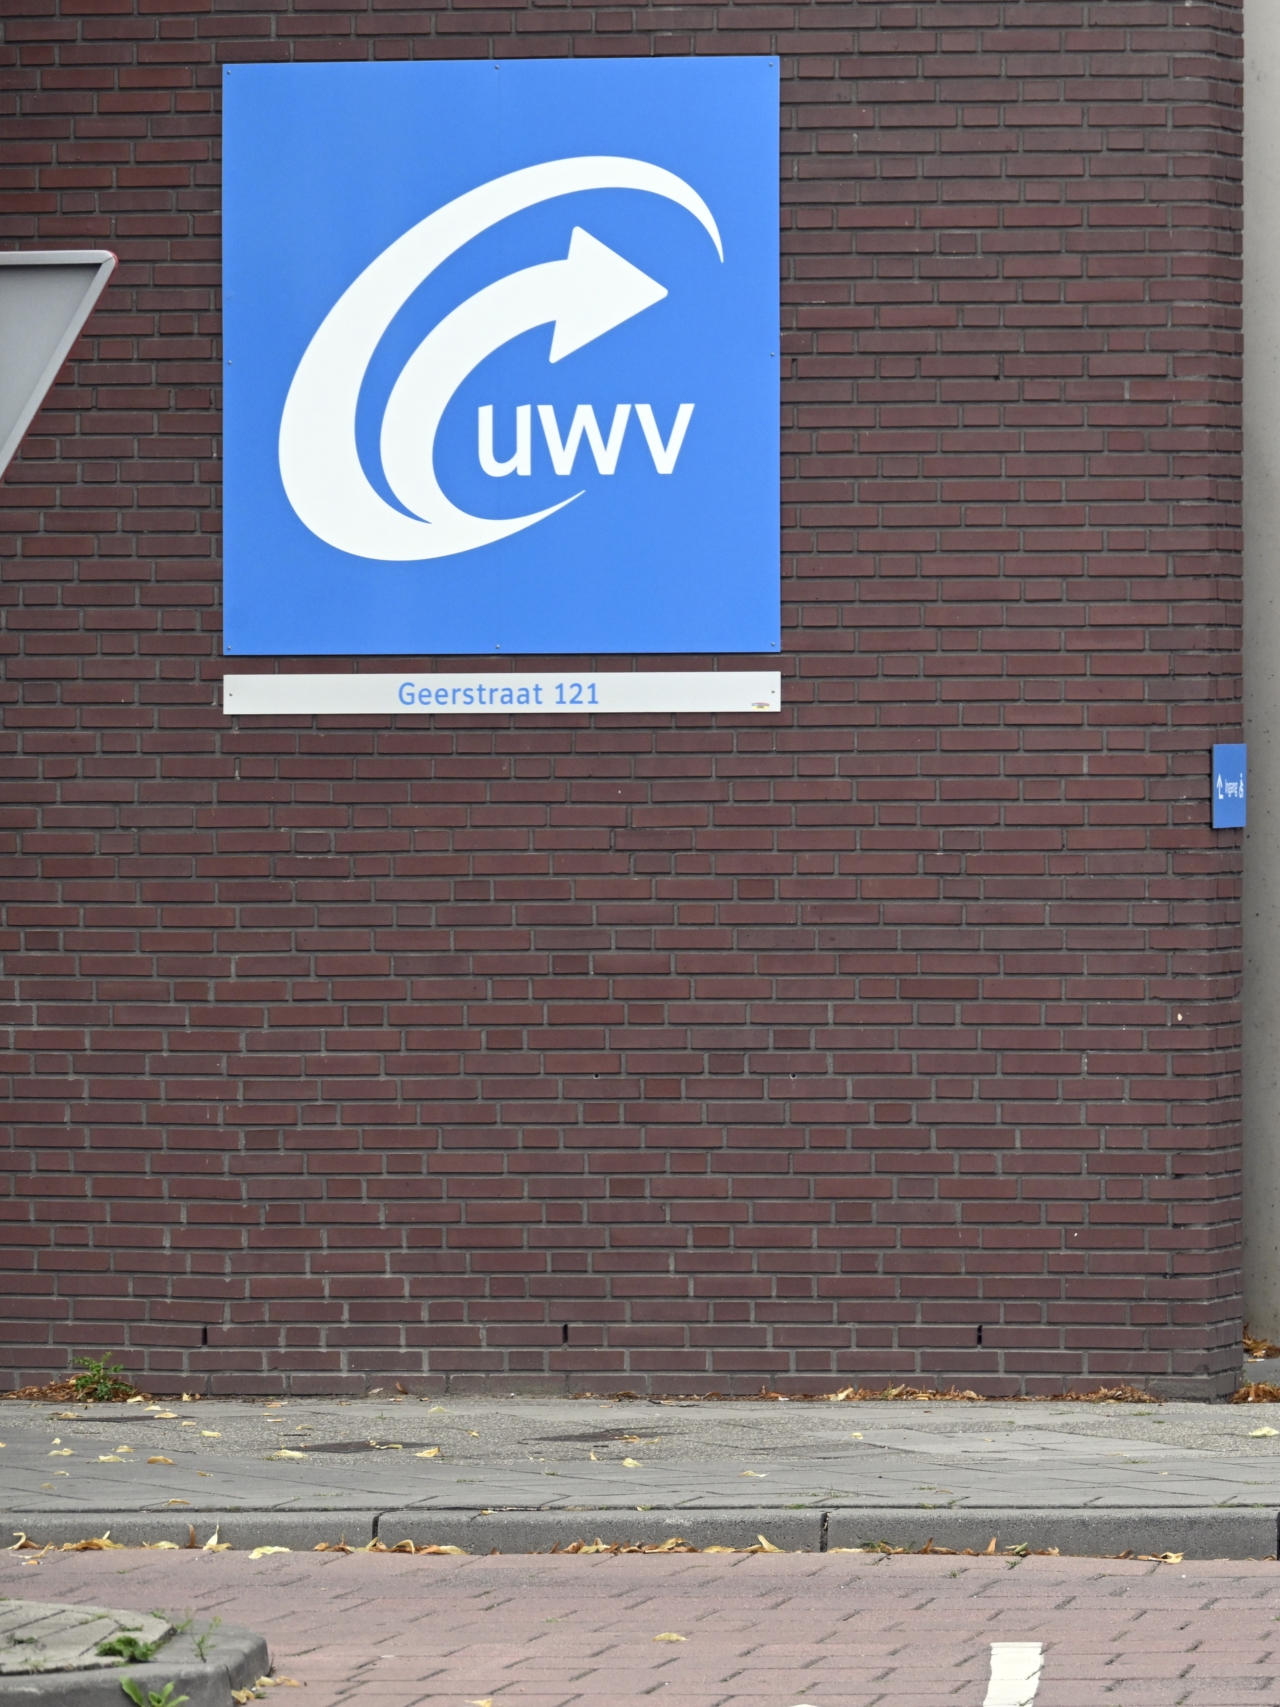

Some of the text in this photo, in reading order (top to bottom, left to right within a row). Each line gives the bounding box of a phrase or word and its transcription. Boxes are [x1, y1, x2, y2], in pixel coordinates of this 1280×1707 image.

[478, 403, 695, 477] uwv
[398, 682, 599, 706] Geerstraat 121
